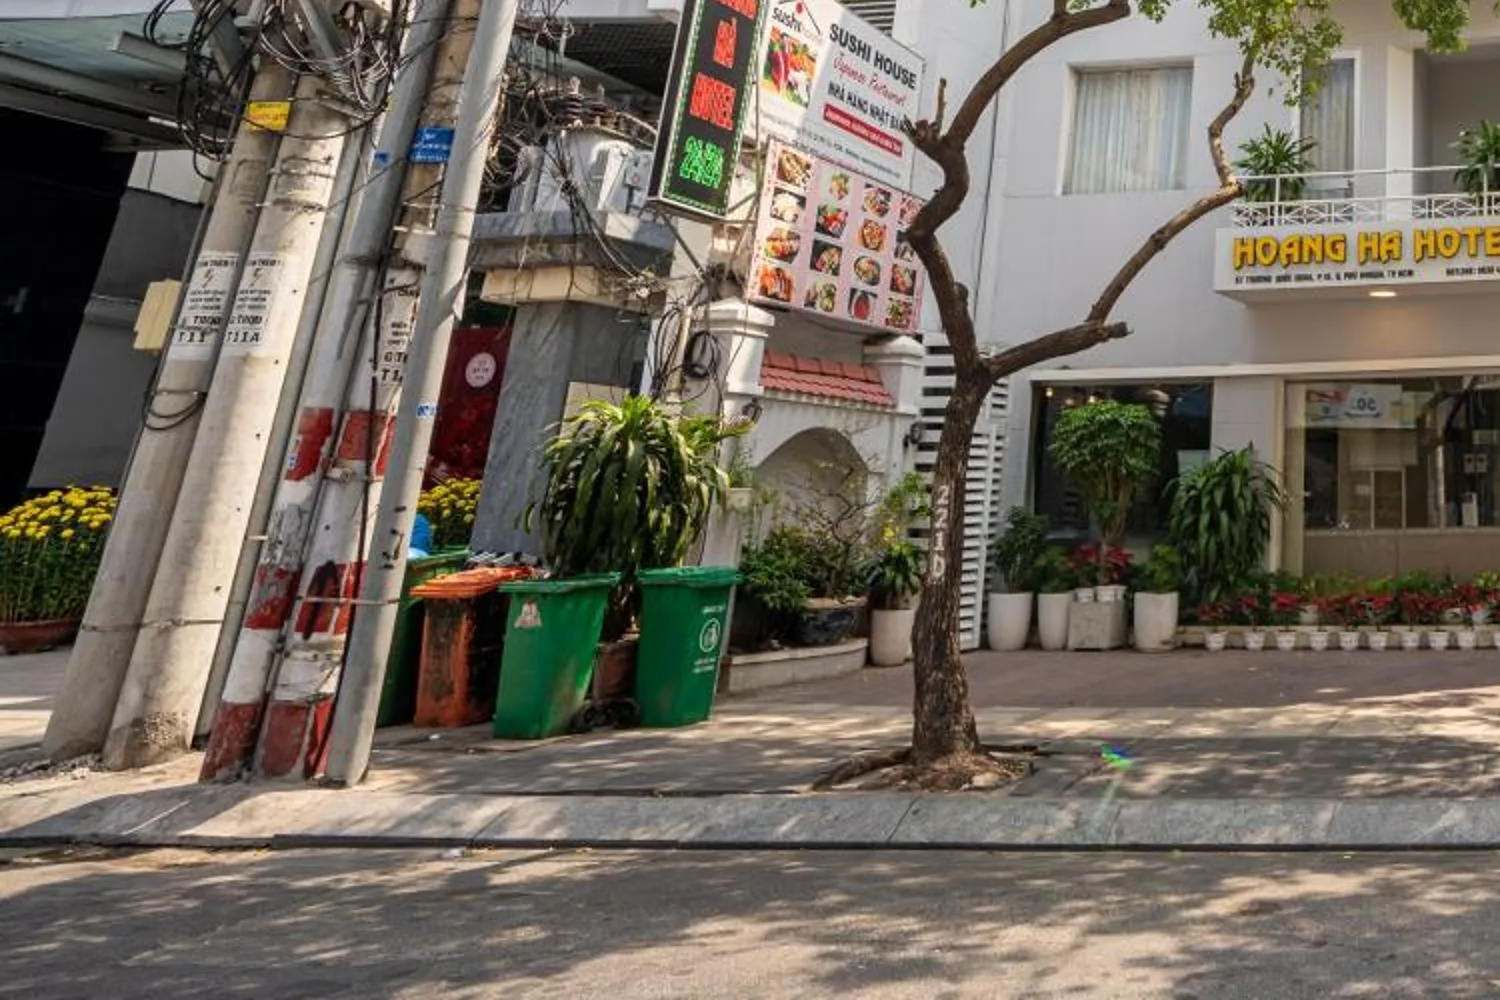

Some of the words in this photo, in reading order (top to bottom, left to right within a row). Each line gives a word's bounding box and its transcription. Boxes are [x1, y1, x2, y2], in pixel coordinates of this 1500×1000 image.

[830, 23, 871, 63] SUSHI
[873, 50, 917, 90] HOUSE
[1232, 233, 1347, 270] HOANG
[1357, 230, 1403, 265] HA
